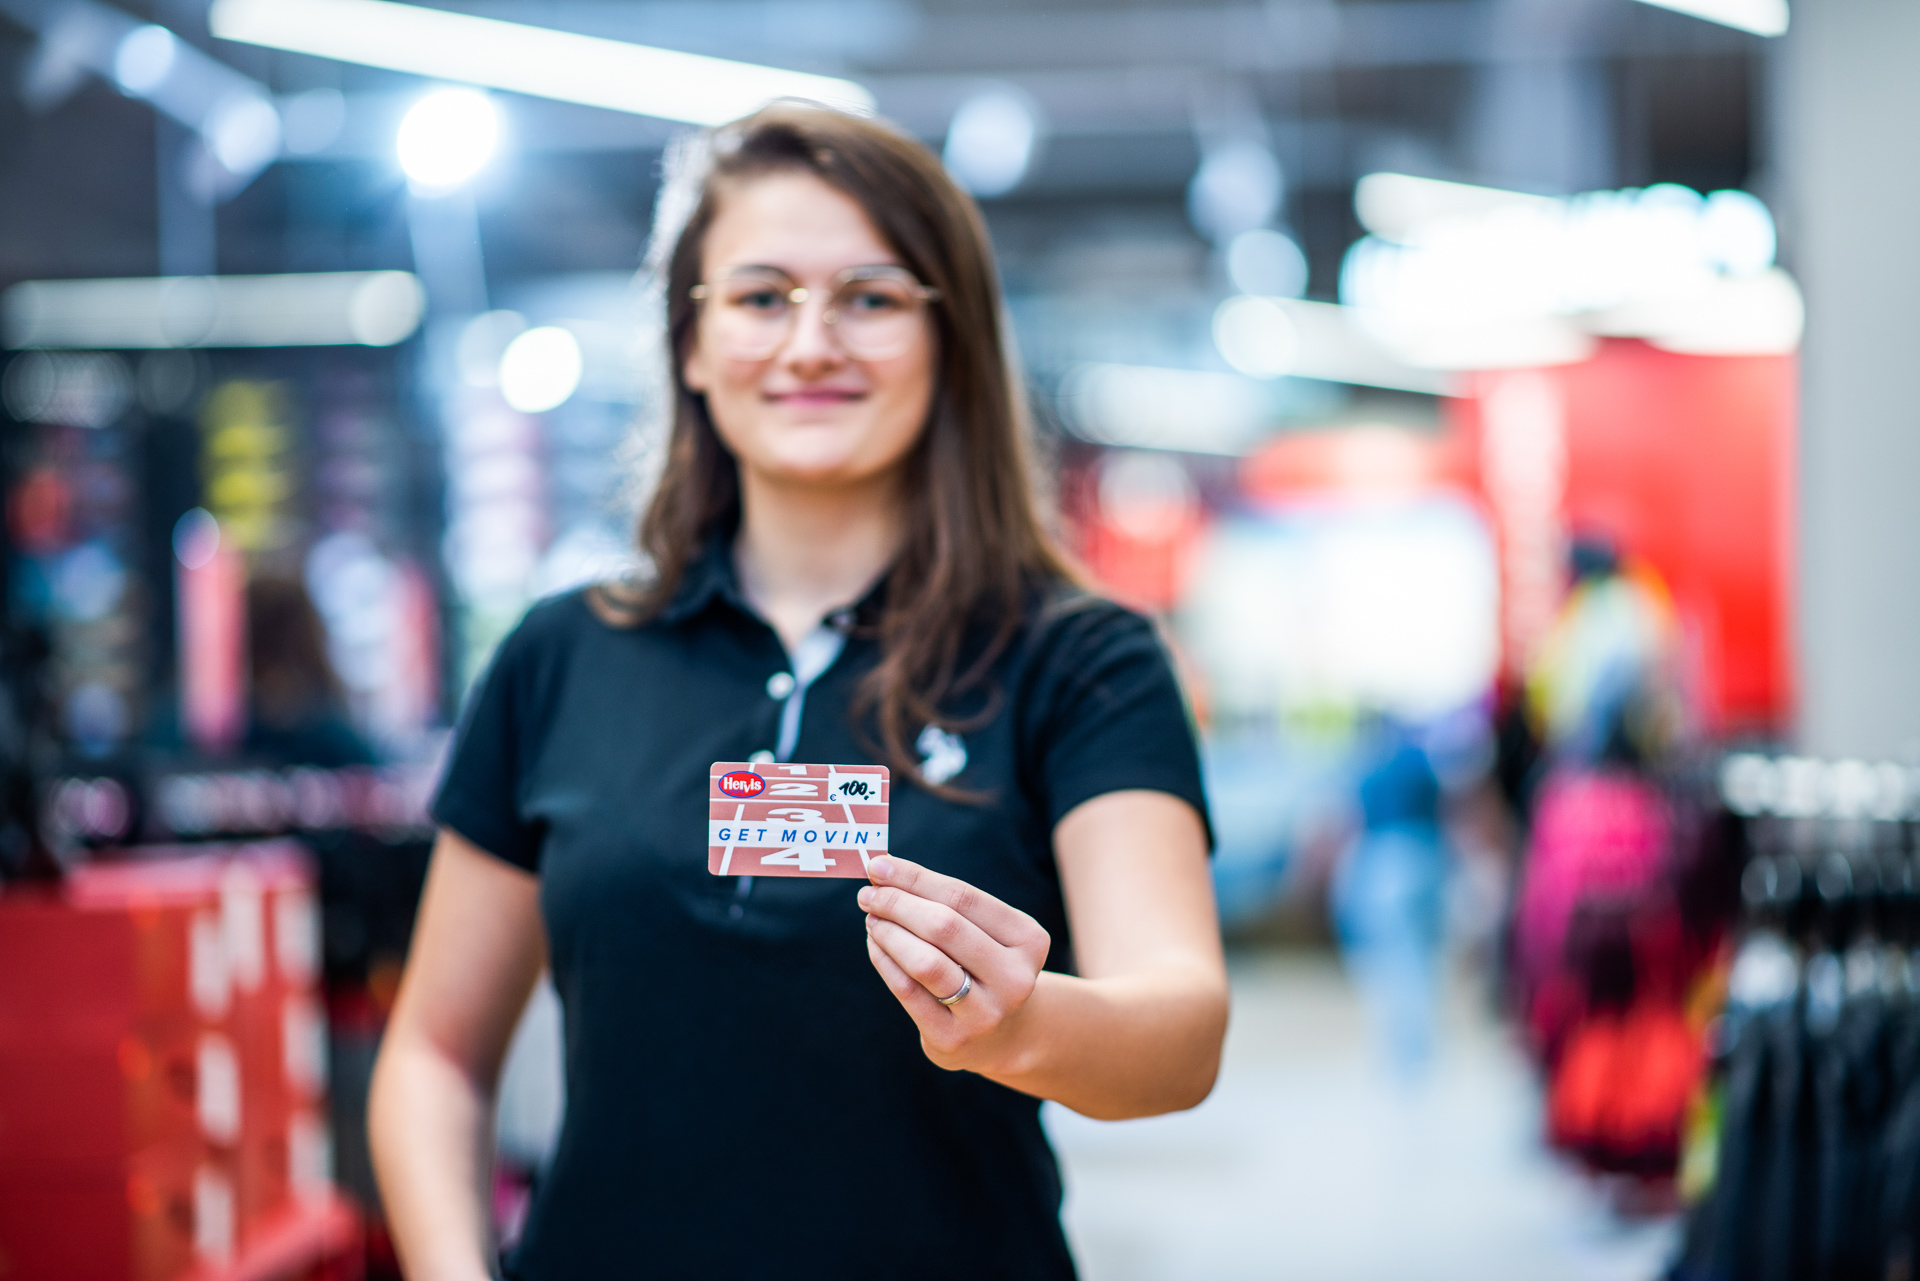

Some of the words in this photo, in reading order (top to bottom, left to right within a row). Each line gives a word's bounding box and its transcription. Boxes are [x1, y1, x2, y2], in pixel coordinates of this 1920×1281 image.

[723, 776, 762, 793] Hervis
[768, 782, 818, 796] 2
[829, 793, 837, 802] €
[765, 807, 826, 827] 3
[718, 828, 768, 842] GET
[760, 845, 837, 872] 4
